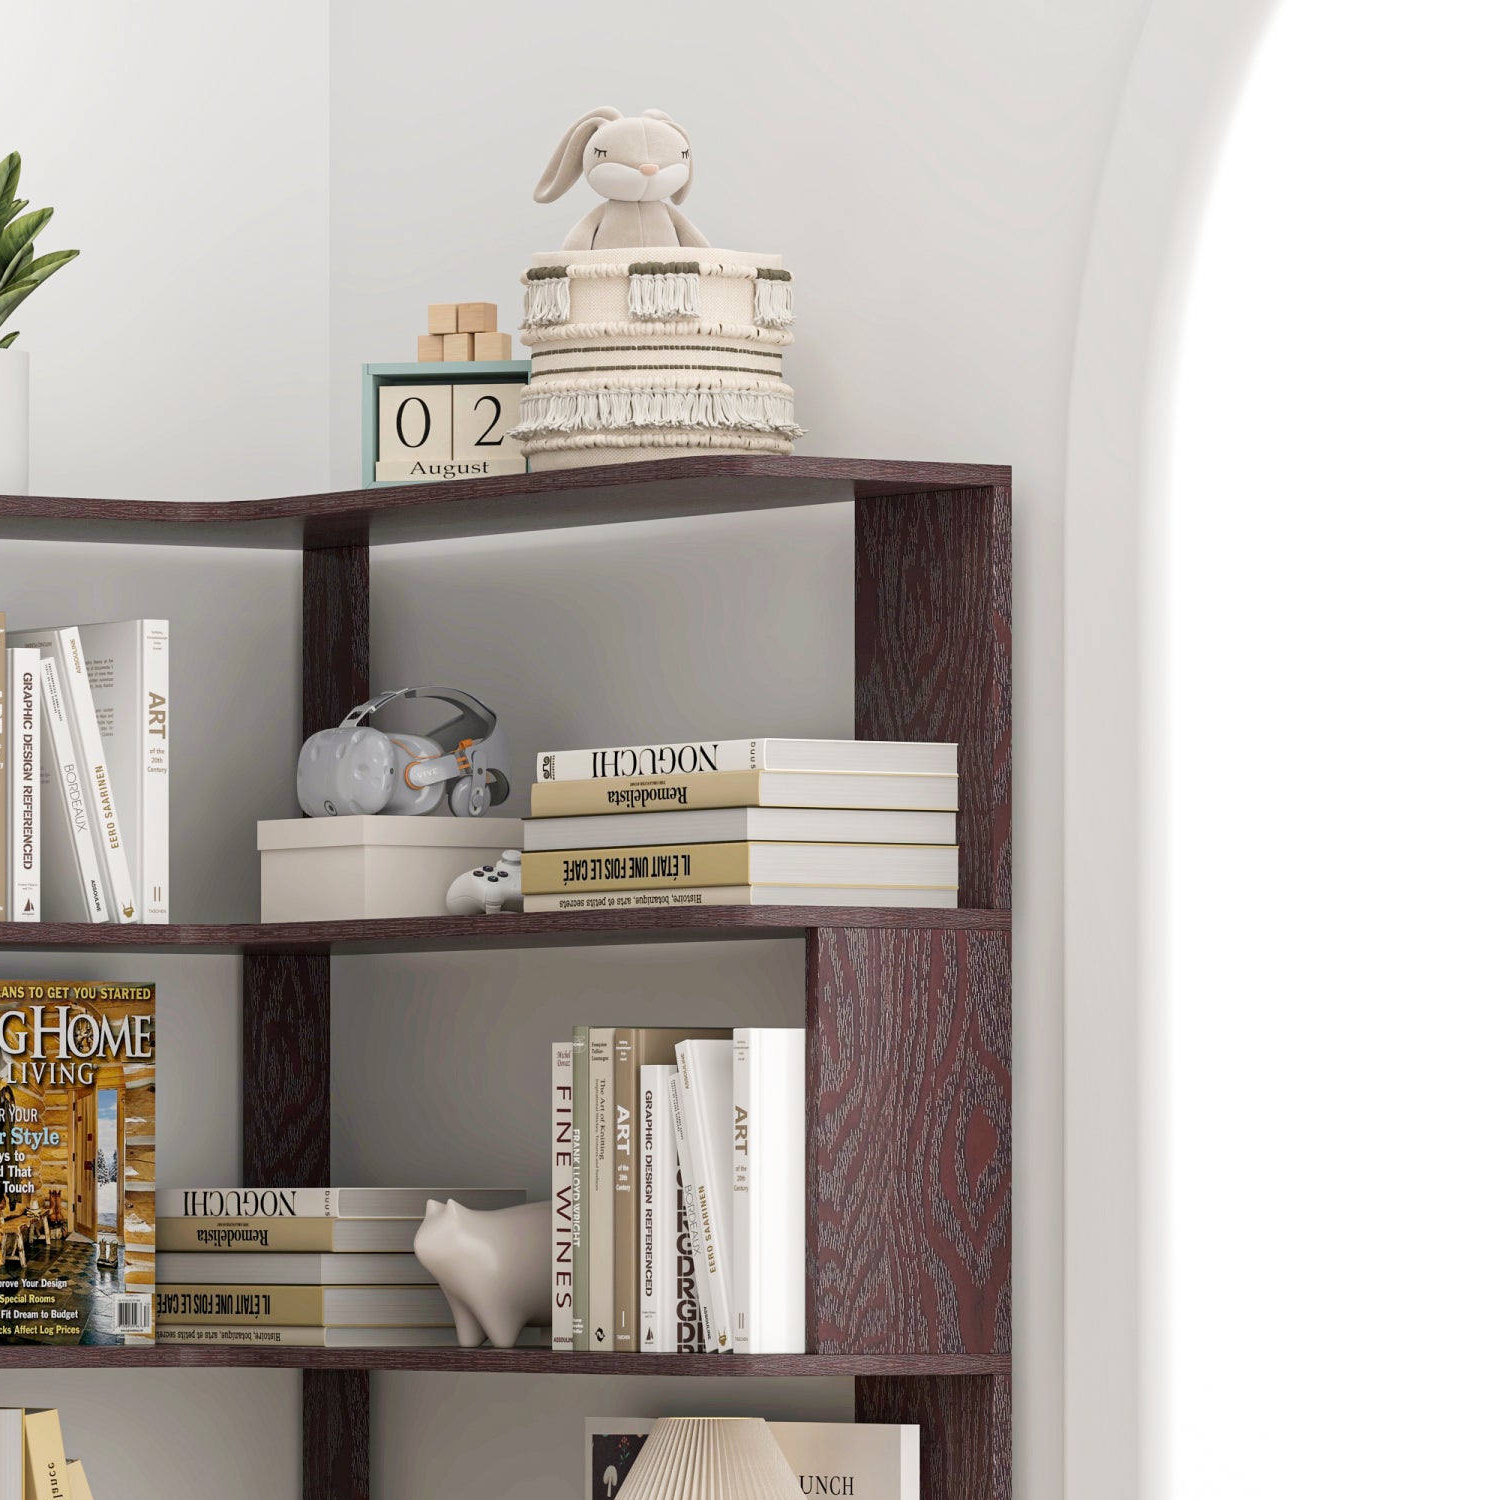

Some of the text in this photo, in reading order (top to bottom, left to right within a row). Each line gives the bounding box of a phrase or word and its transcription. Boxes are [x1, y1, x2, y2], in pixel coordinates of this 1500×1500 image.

[396, 396, 504, 448] 0 2
[410, 461, 489, 479] August
[23, 672, 33, 870] GRAPHIC DESIGN REFERENCED
[591, 744, 719, 778] NOGUCHI
[64, 764, 87, 832] BORDEAUX
[94, 765, 119, 849] EERO SAARINEN
[607, 786, 688, 808] Remodelista
[563, 855, 691, 886] IL ÉTAIT UNE FOIS LE CAFÉ
[7, 1062, 94, 1085] LIVING
[616, 1105, 630, 1155] ART
[183, 1190, 297, 1217] NOGUCHI
[556, 1085, 572, 1308] FINE WINES
[645, 1090, 653, 1297] GRAPHIC DESIGN REFERENCED
[22, 1279, 39, 1288] Your
[41, 1279, 68, 1290] Design
[14, 1325, 38, 1335] Affect
[40, 1326, 54, 1336] Log
[56, 1326, 80, 1335] Prices
